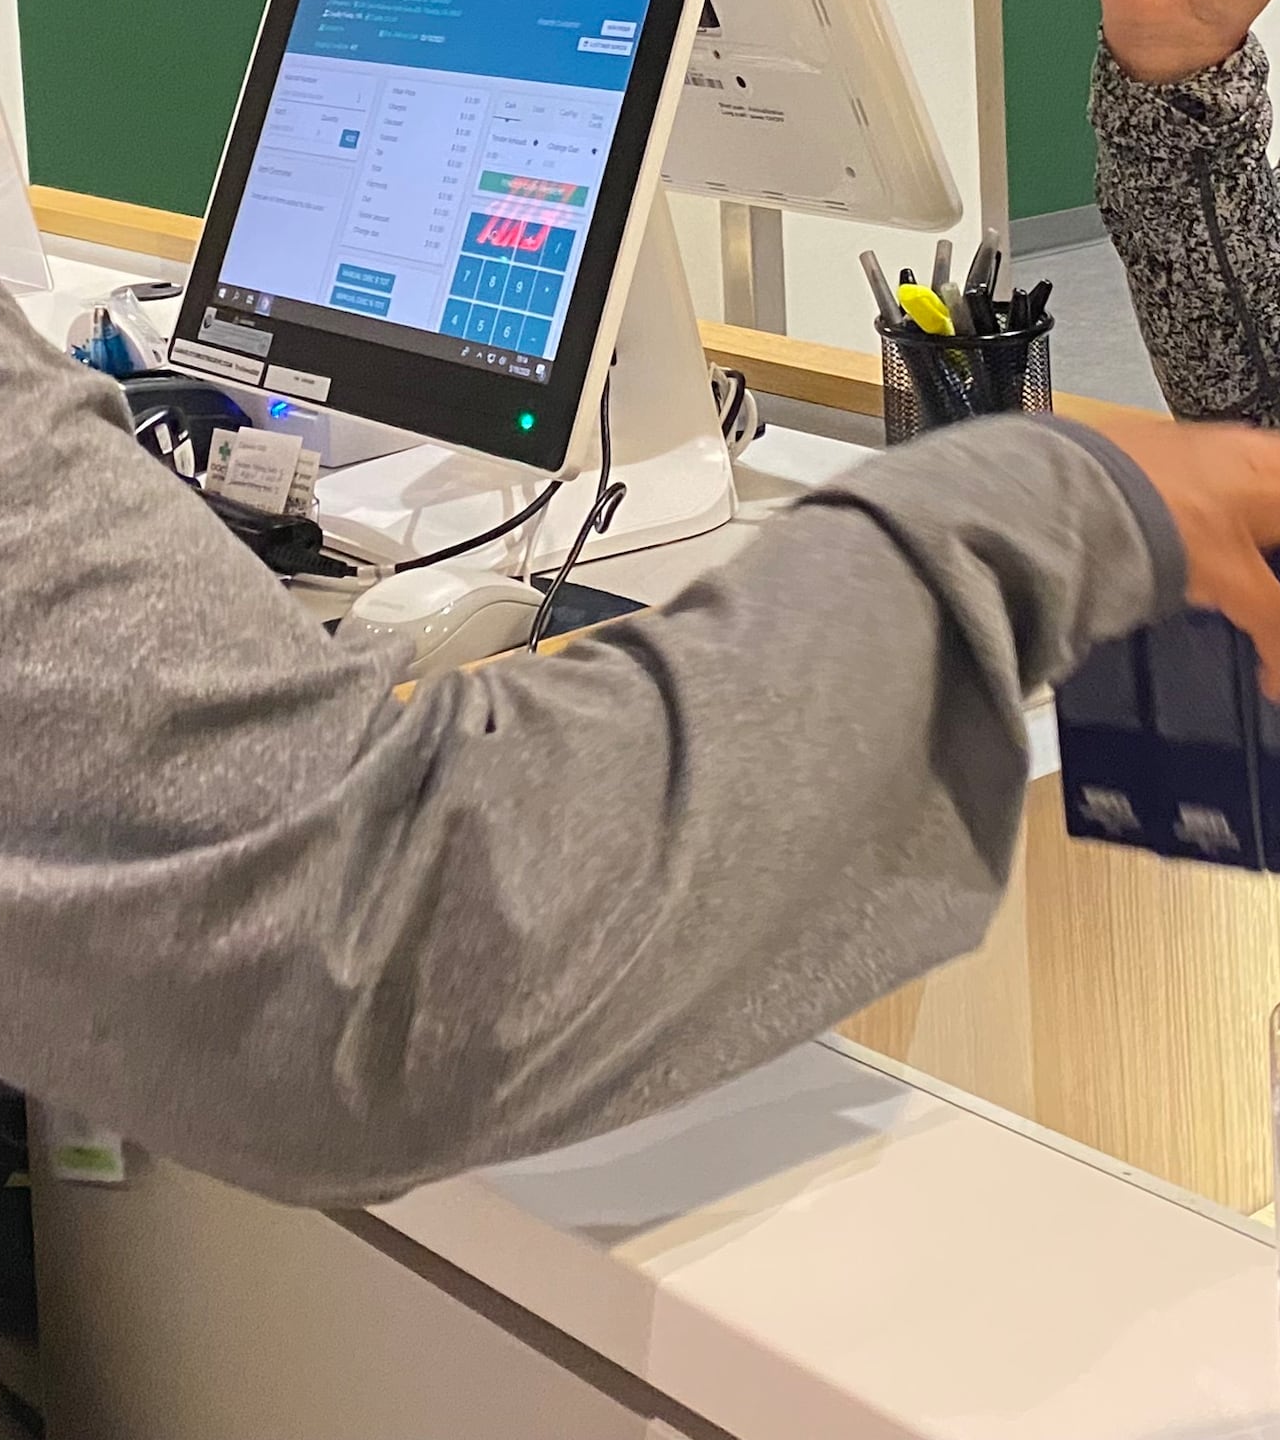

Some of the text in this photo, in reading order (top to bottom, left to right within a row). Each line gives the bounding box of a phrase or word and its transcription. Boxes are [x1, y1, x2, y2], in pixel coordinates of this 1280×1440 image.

[463, 270, 524, 294] 7 8 9
[450, 314, 512, 339] 4 5 6
